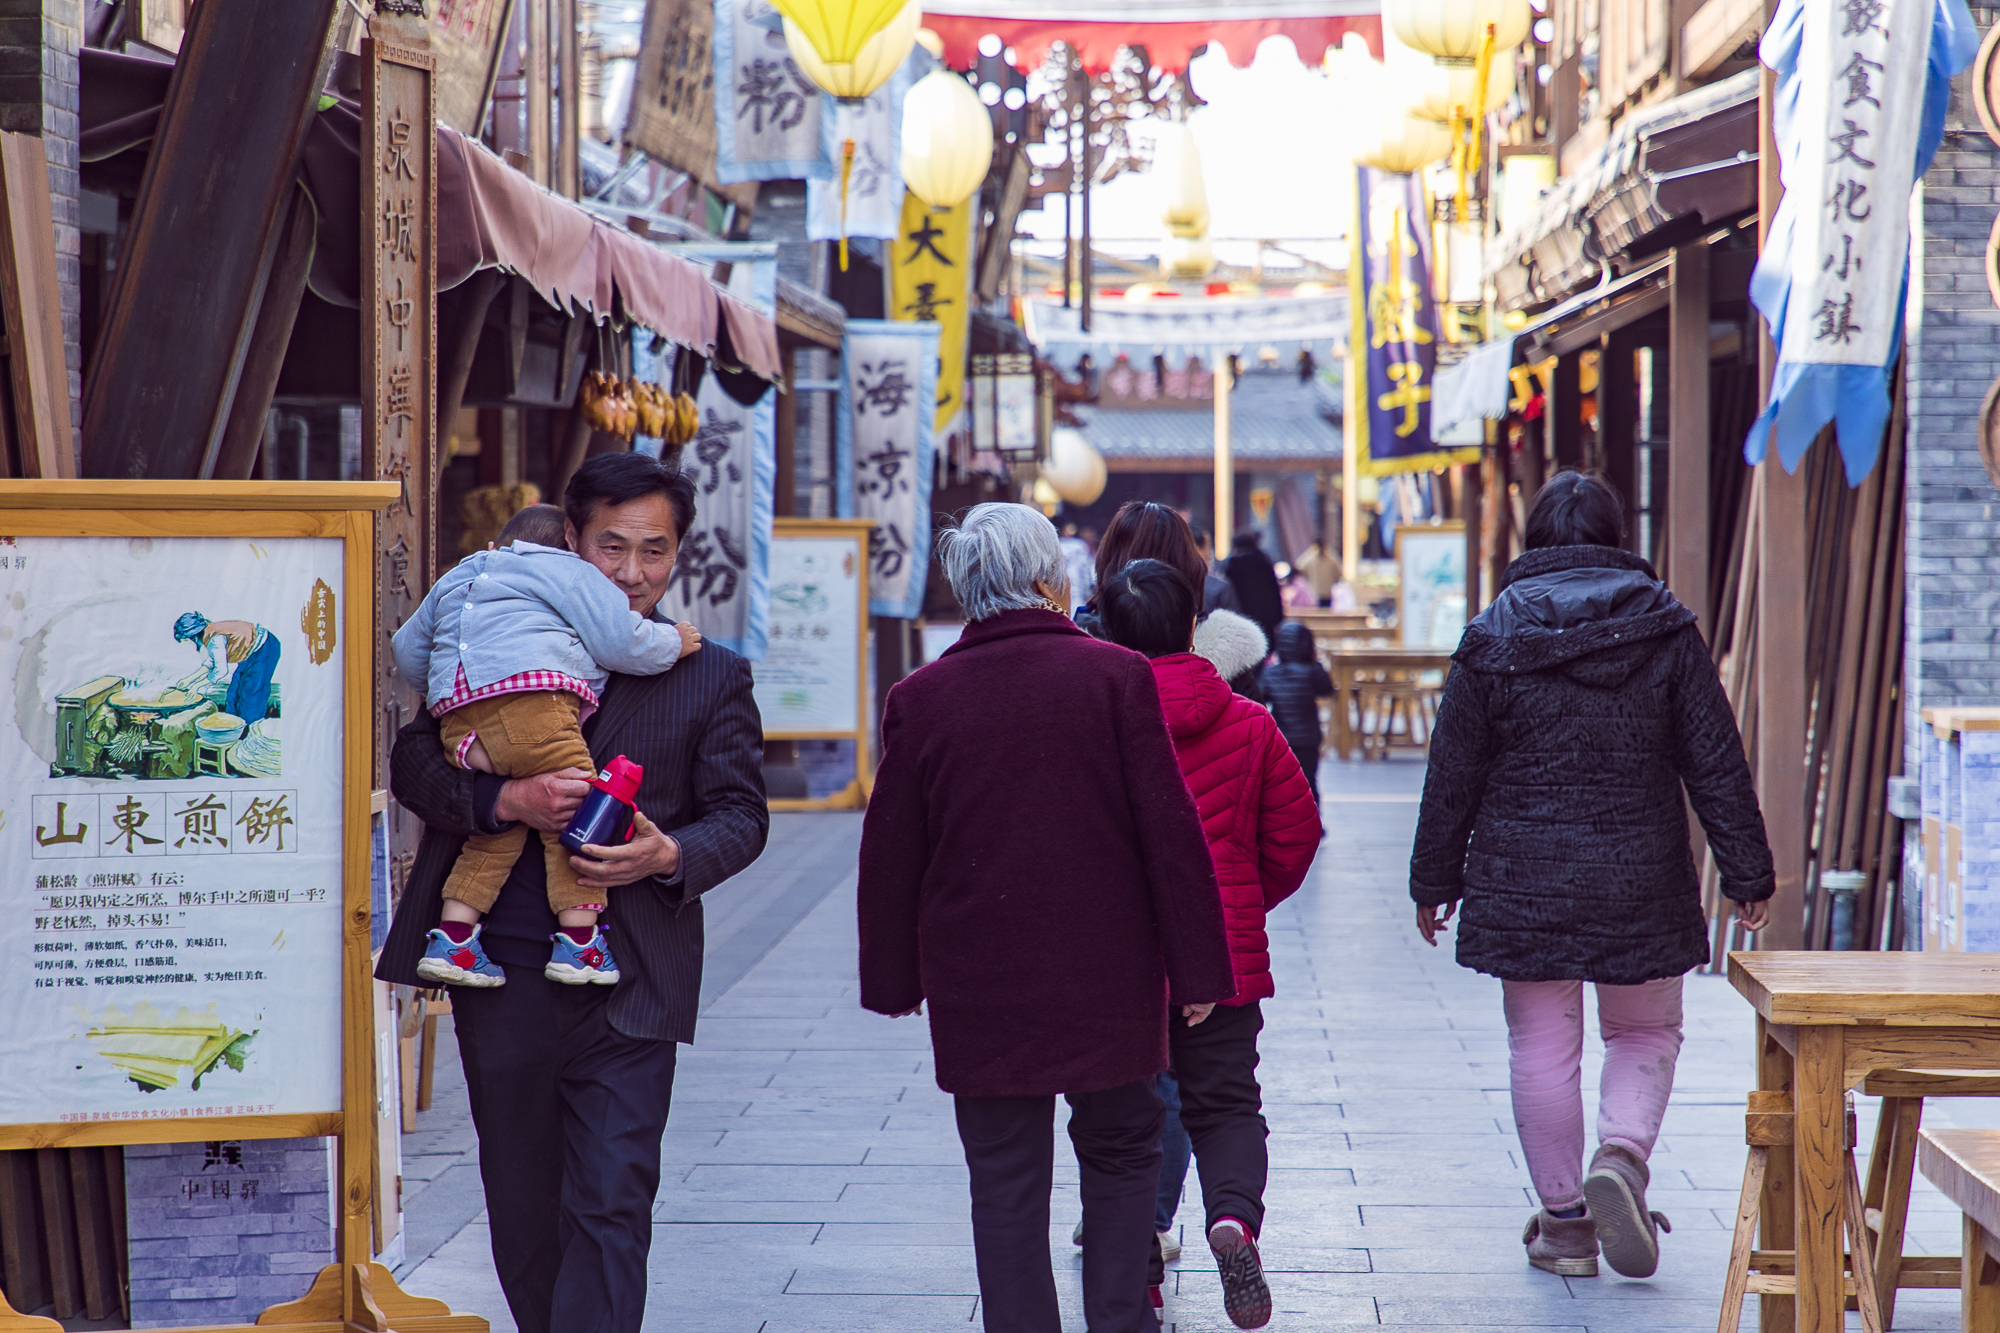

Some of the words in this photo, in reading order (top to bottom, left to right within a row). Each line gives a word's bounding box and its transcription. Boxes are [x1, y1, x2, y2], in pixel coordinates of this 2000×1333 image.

[382, 106, 419, 640] 泉城中華飲食
[36, 793, 294, 853] 山東煎餅
